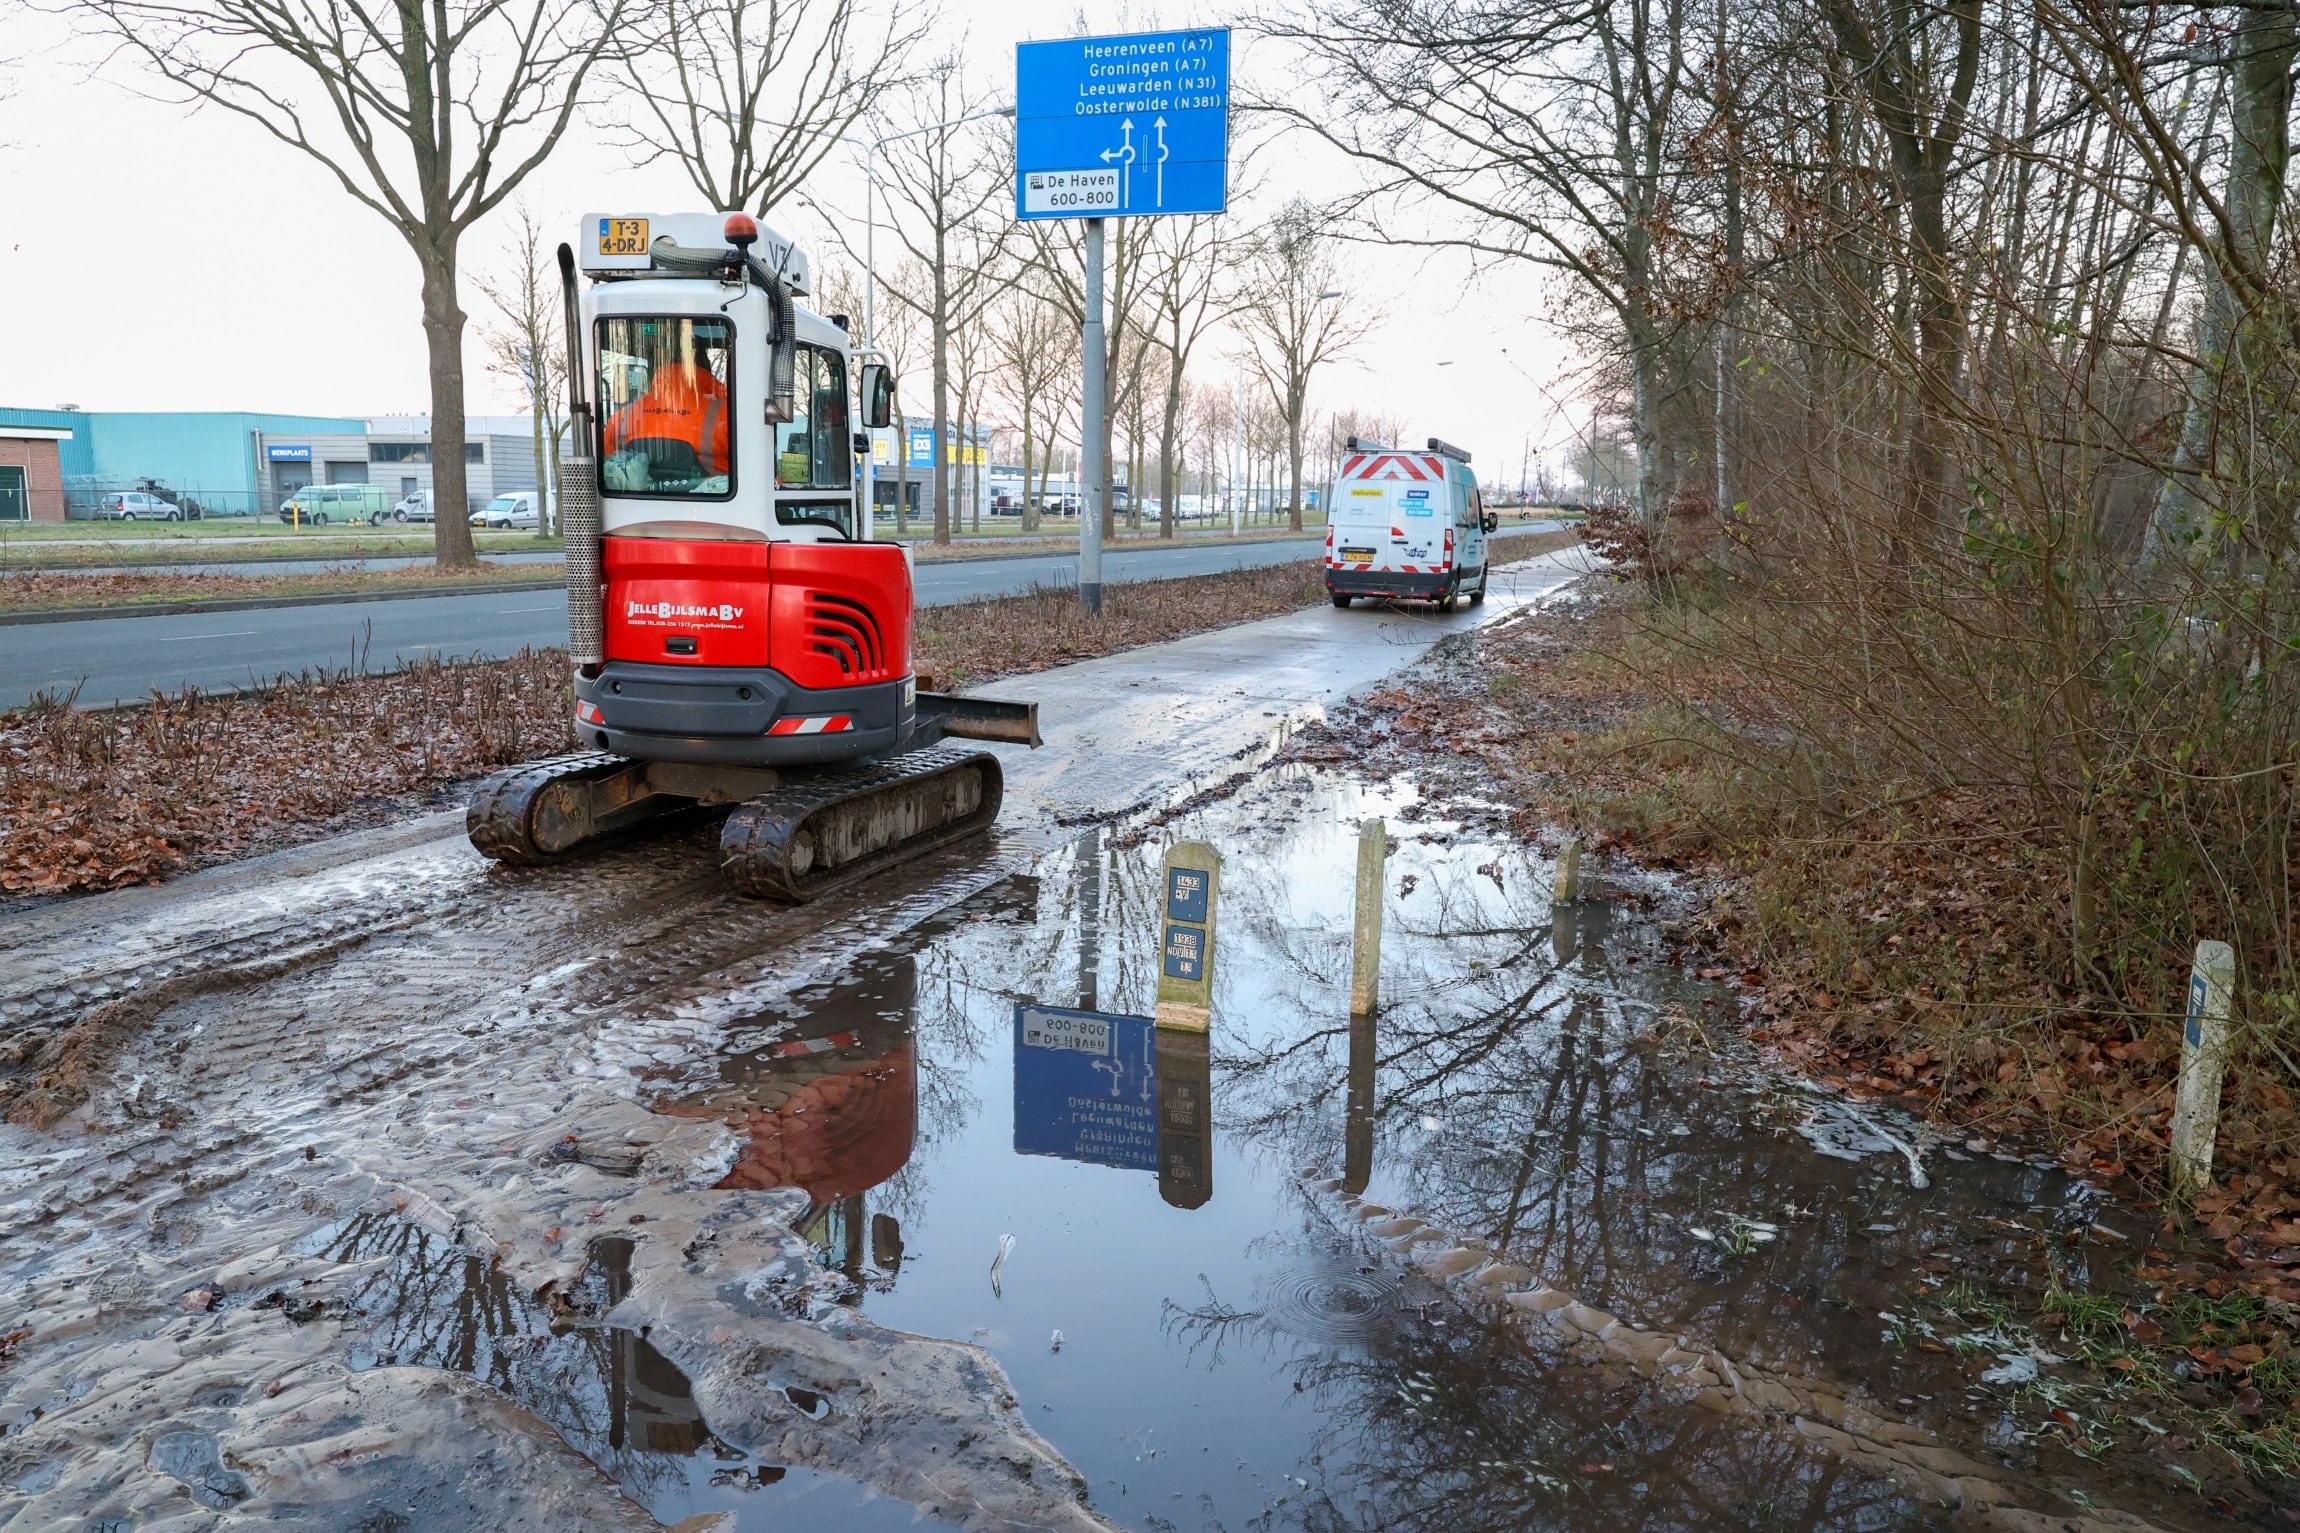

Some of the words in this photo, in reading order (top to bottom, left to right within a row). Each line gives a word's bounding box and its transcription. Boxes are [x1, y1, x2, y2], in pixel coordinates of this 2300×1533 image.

[1084, 41, 1175, 59] Heerenveen
[1090, 60, 1169, 77] Groningen
[1080, 78, 1172, 97] Leeuwarden
[1075, 98, 1168, 115] Oosterwolde
[1048, 176, 1065, 188] De
[1070, 174, 1115, 187] Haven
[1050, 191, 1114, 206] 600-800
[616, 221, 640, 236] T-3
[602, 237, 645, 252] 4-DRJ
[1178, 876, 1199, 887] 1433
[1175, 934, 1196, 945] 1938
